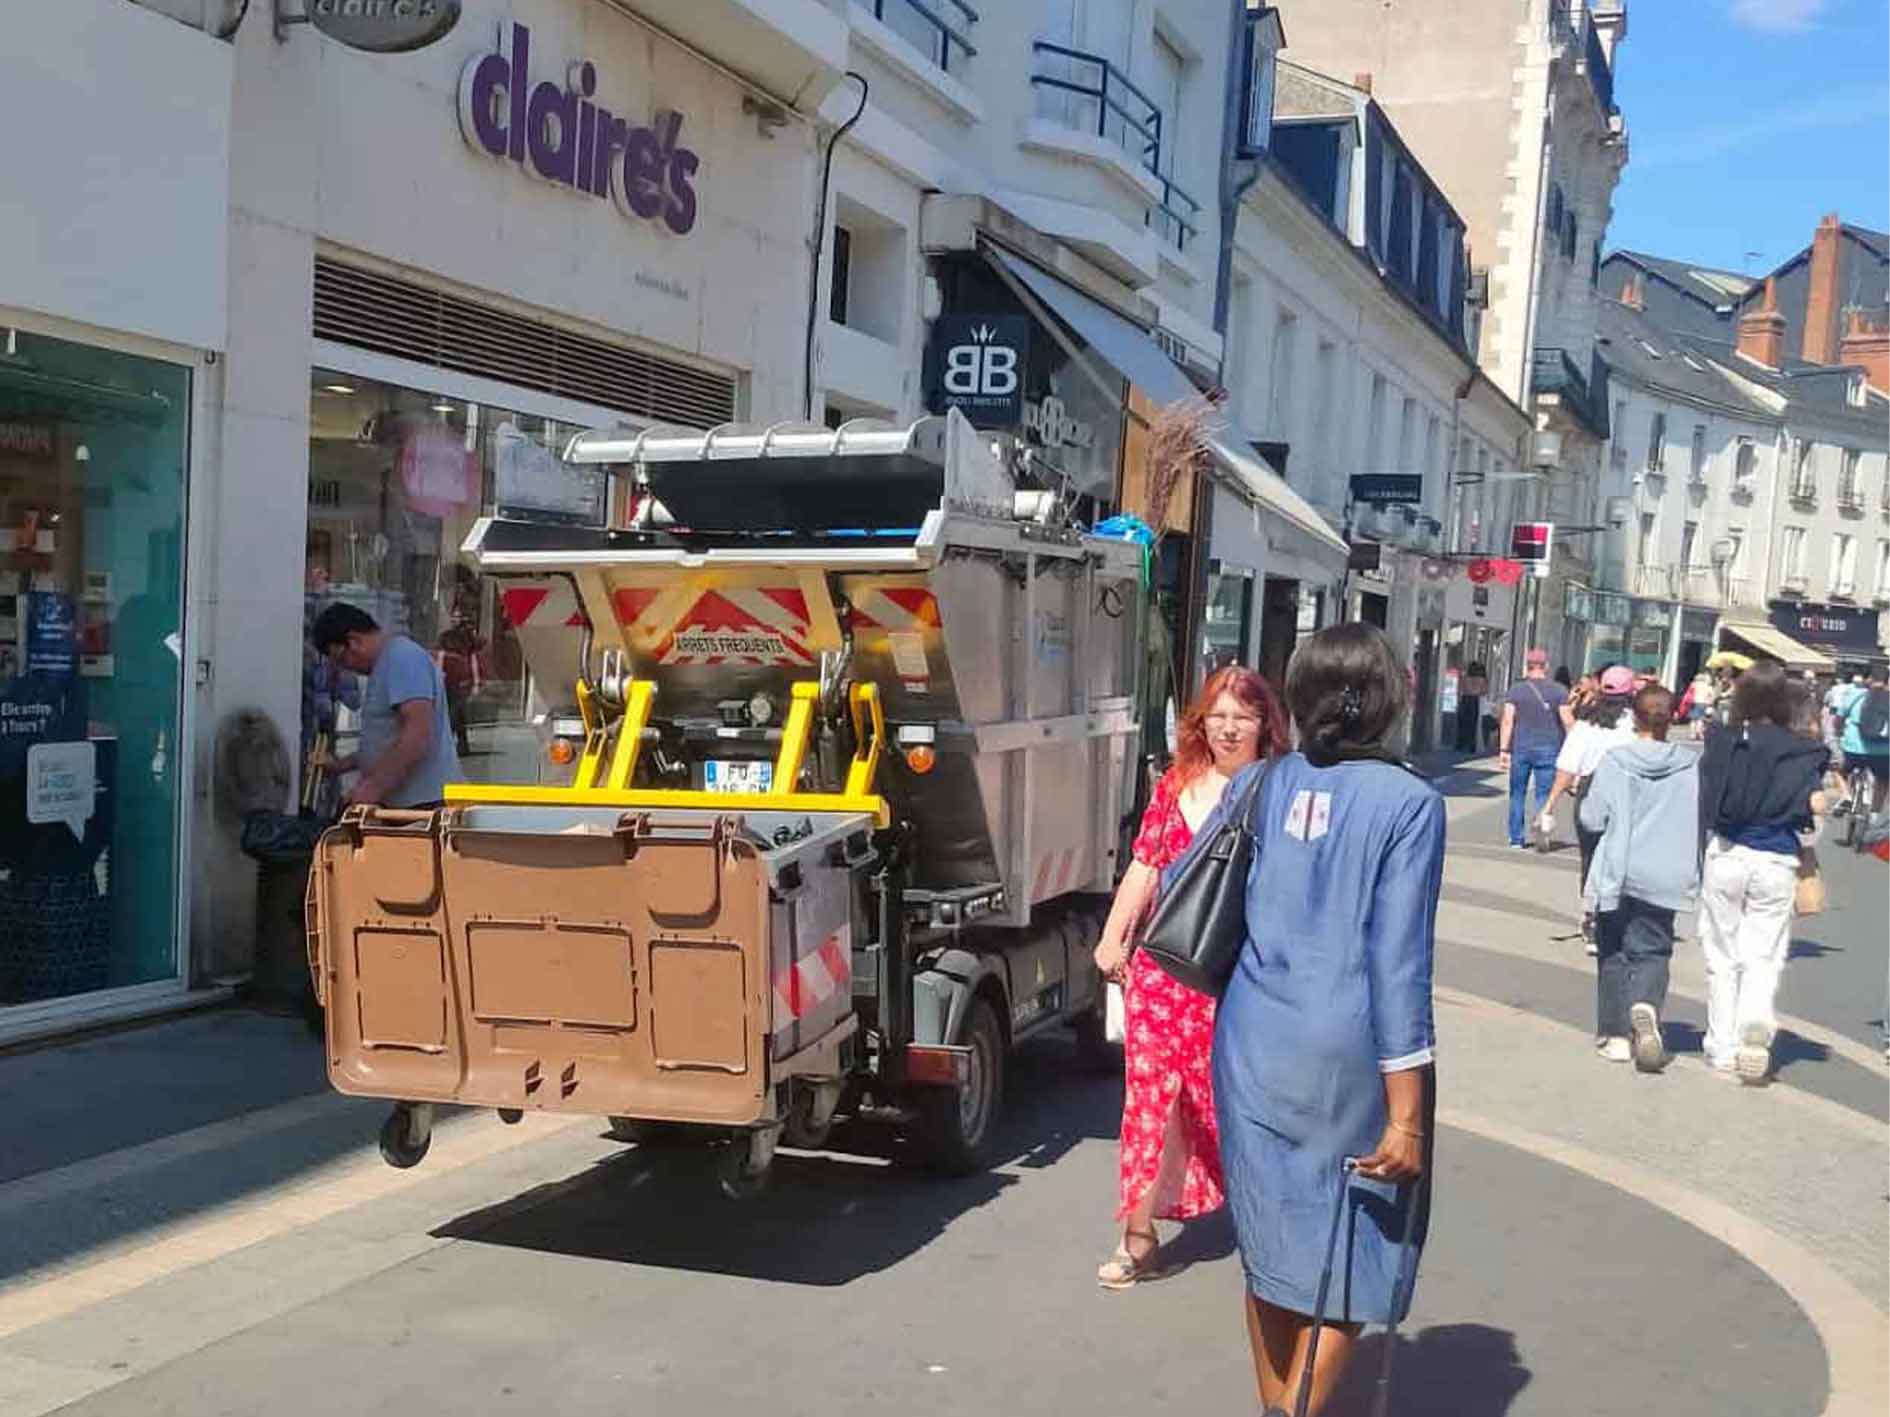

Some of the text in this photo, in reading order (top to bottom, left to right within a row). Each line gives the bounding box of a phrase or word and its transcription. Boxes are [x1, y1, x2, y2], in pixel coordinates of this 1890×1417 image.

[315, 0, 435, 17] claires
[463, 20, 700, 236] claire's
[944, 345, 1018, 395] BB
[677, 636, 785, 654] ARRETS FREQUENTS
